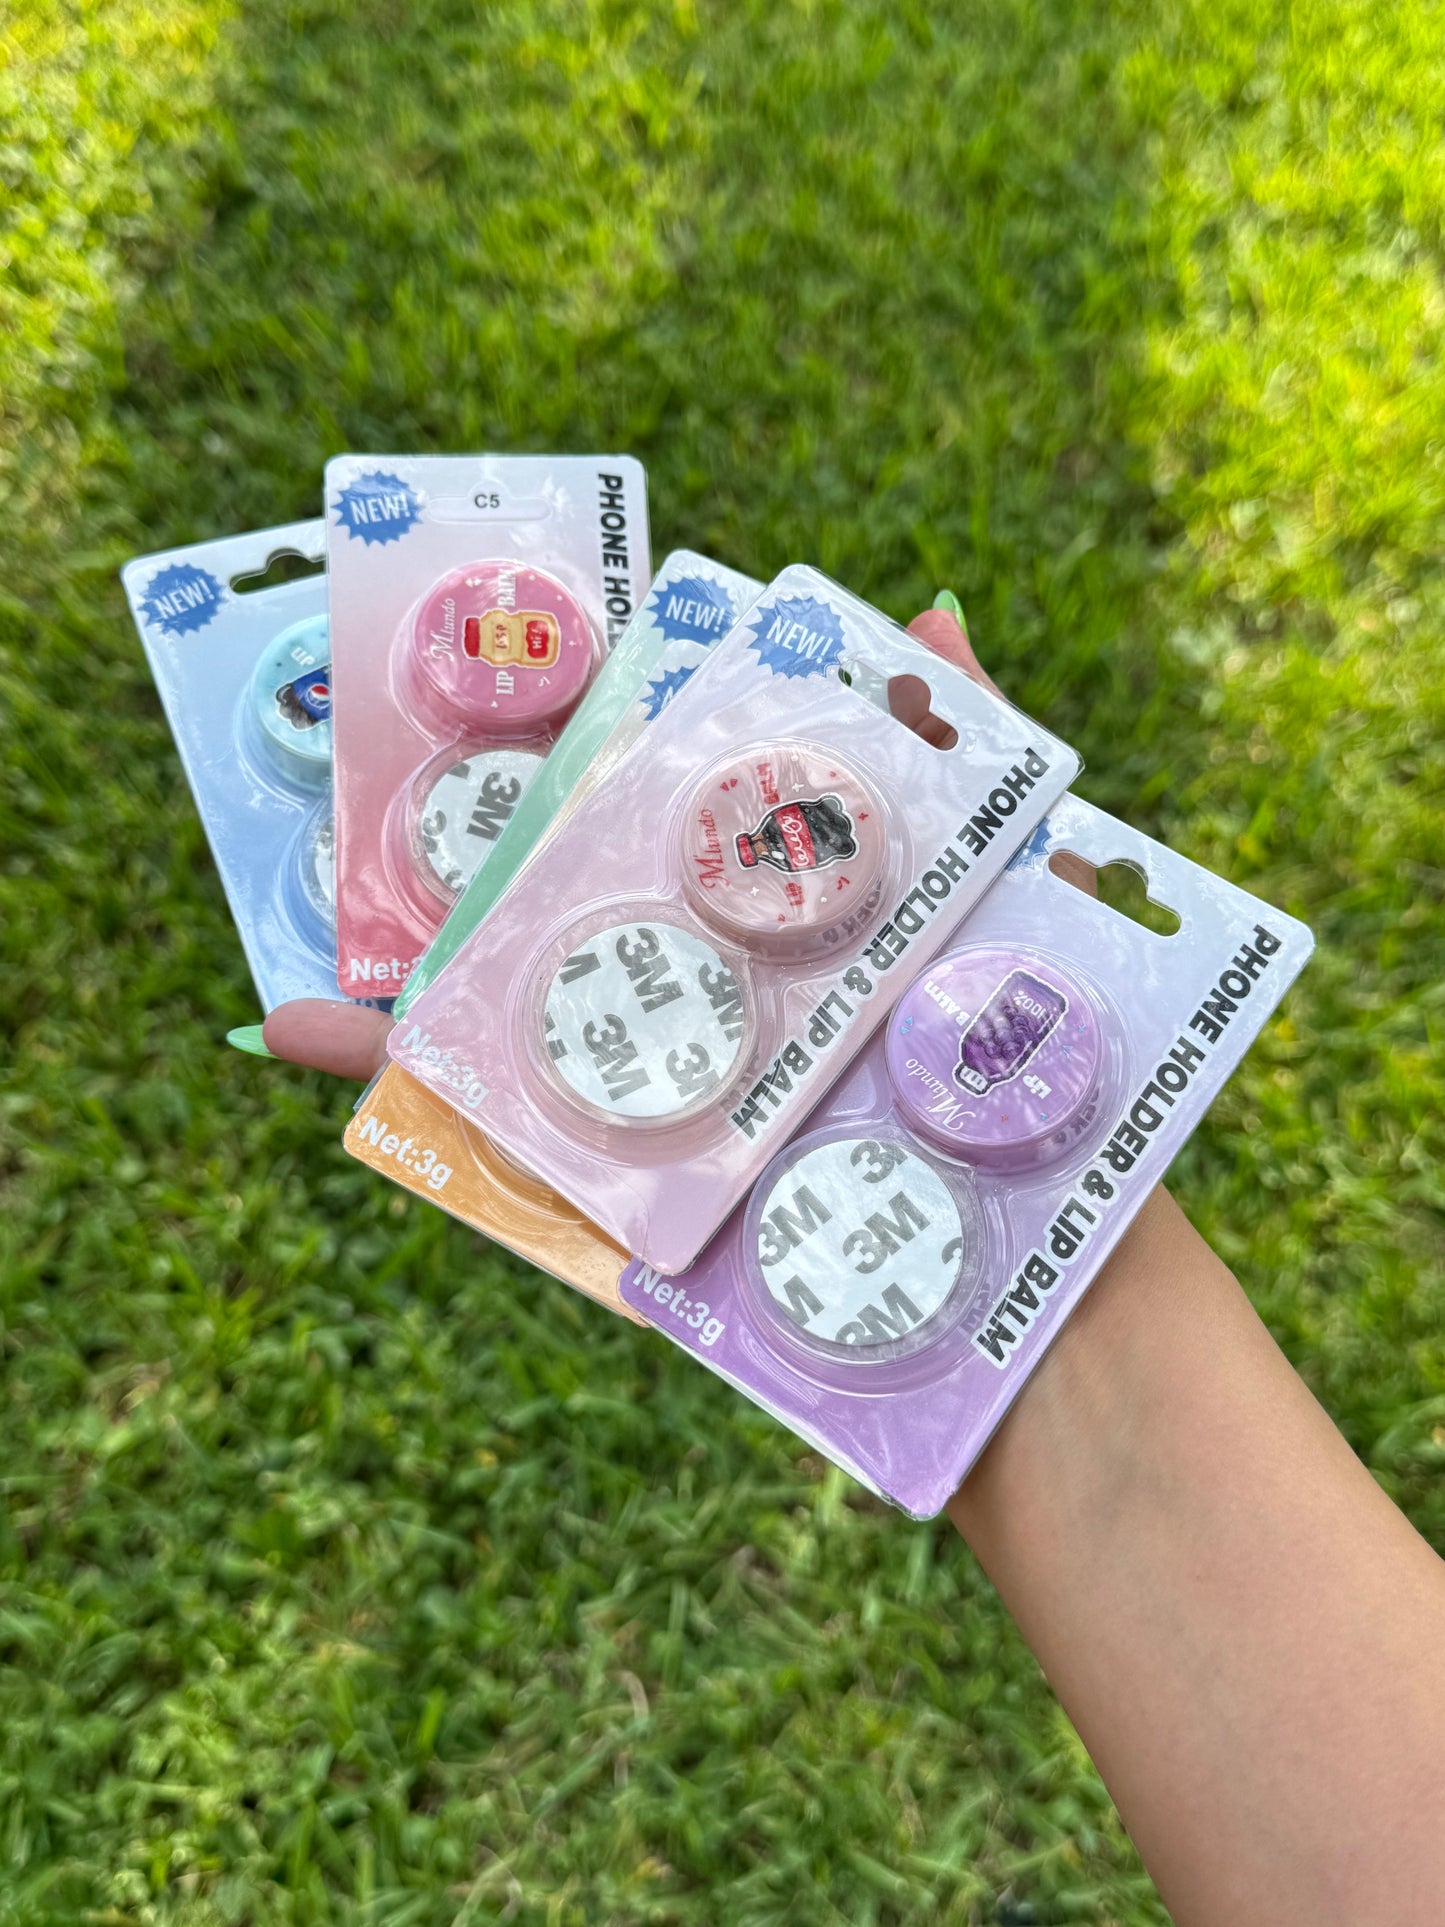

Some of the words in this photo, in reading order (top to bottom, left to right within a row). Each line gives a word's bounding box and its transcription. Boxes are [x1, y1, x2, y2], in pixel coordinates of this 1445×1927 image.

[351, 494, 411, 525] NEW!
[474, 494, 500, 508] C5
[598, 473, 629, 569] PHONE
[155, 577, 215, 619] NEW!
[665, 595, 726, 633] NEW!
[766, 614, 834, 664] NEW!
[496, 671, 515, 695] LIP
[466, 772, 522, 841] 3M
[956, 748, 1050, 857] PHONE
[861, 846, 970, 972] HOLDER
[616, 928, 684, 1013] 3M
[842, 966, 873, 996] &
[1188, 925, 1283, 1045] PHONE
[583, 1013, 651, 1102] 3M
[807, 990, 855, 1048] LIP
[401, 1024, 489, 1109] Net:3g
[730, 1040, 814, 1141] BALM
[1100, 1035, 1206, 1174] HOLDER
[358, 1116, 453, 1191] Net:3g
[1081, 1169, 1115, 1200] &
[758, 1184, 833, 1266] 3M
[843, 1191, 931, 1274] 3M
[1049, 1196, 1097, 1260] LIP
[632, 1264, 727, 1347] Net:3g
[976, 1253, 1060, 1363] BALM
